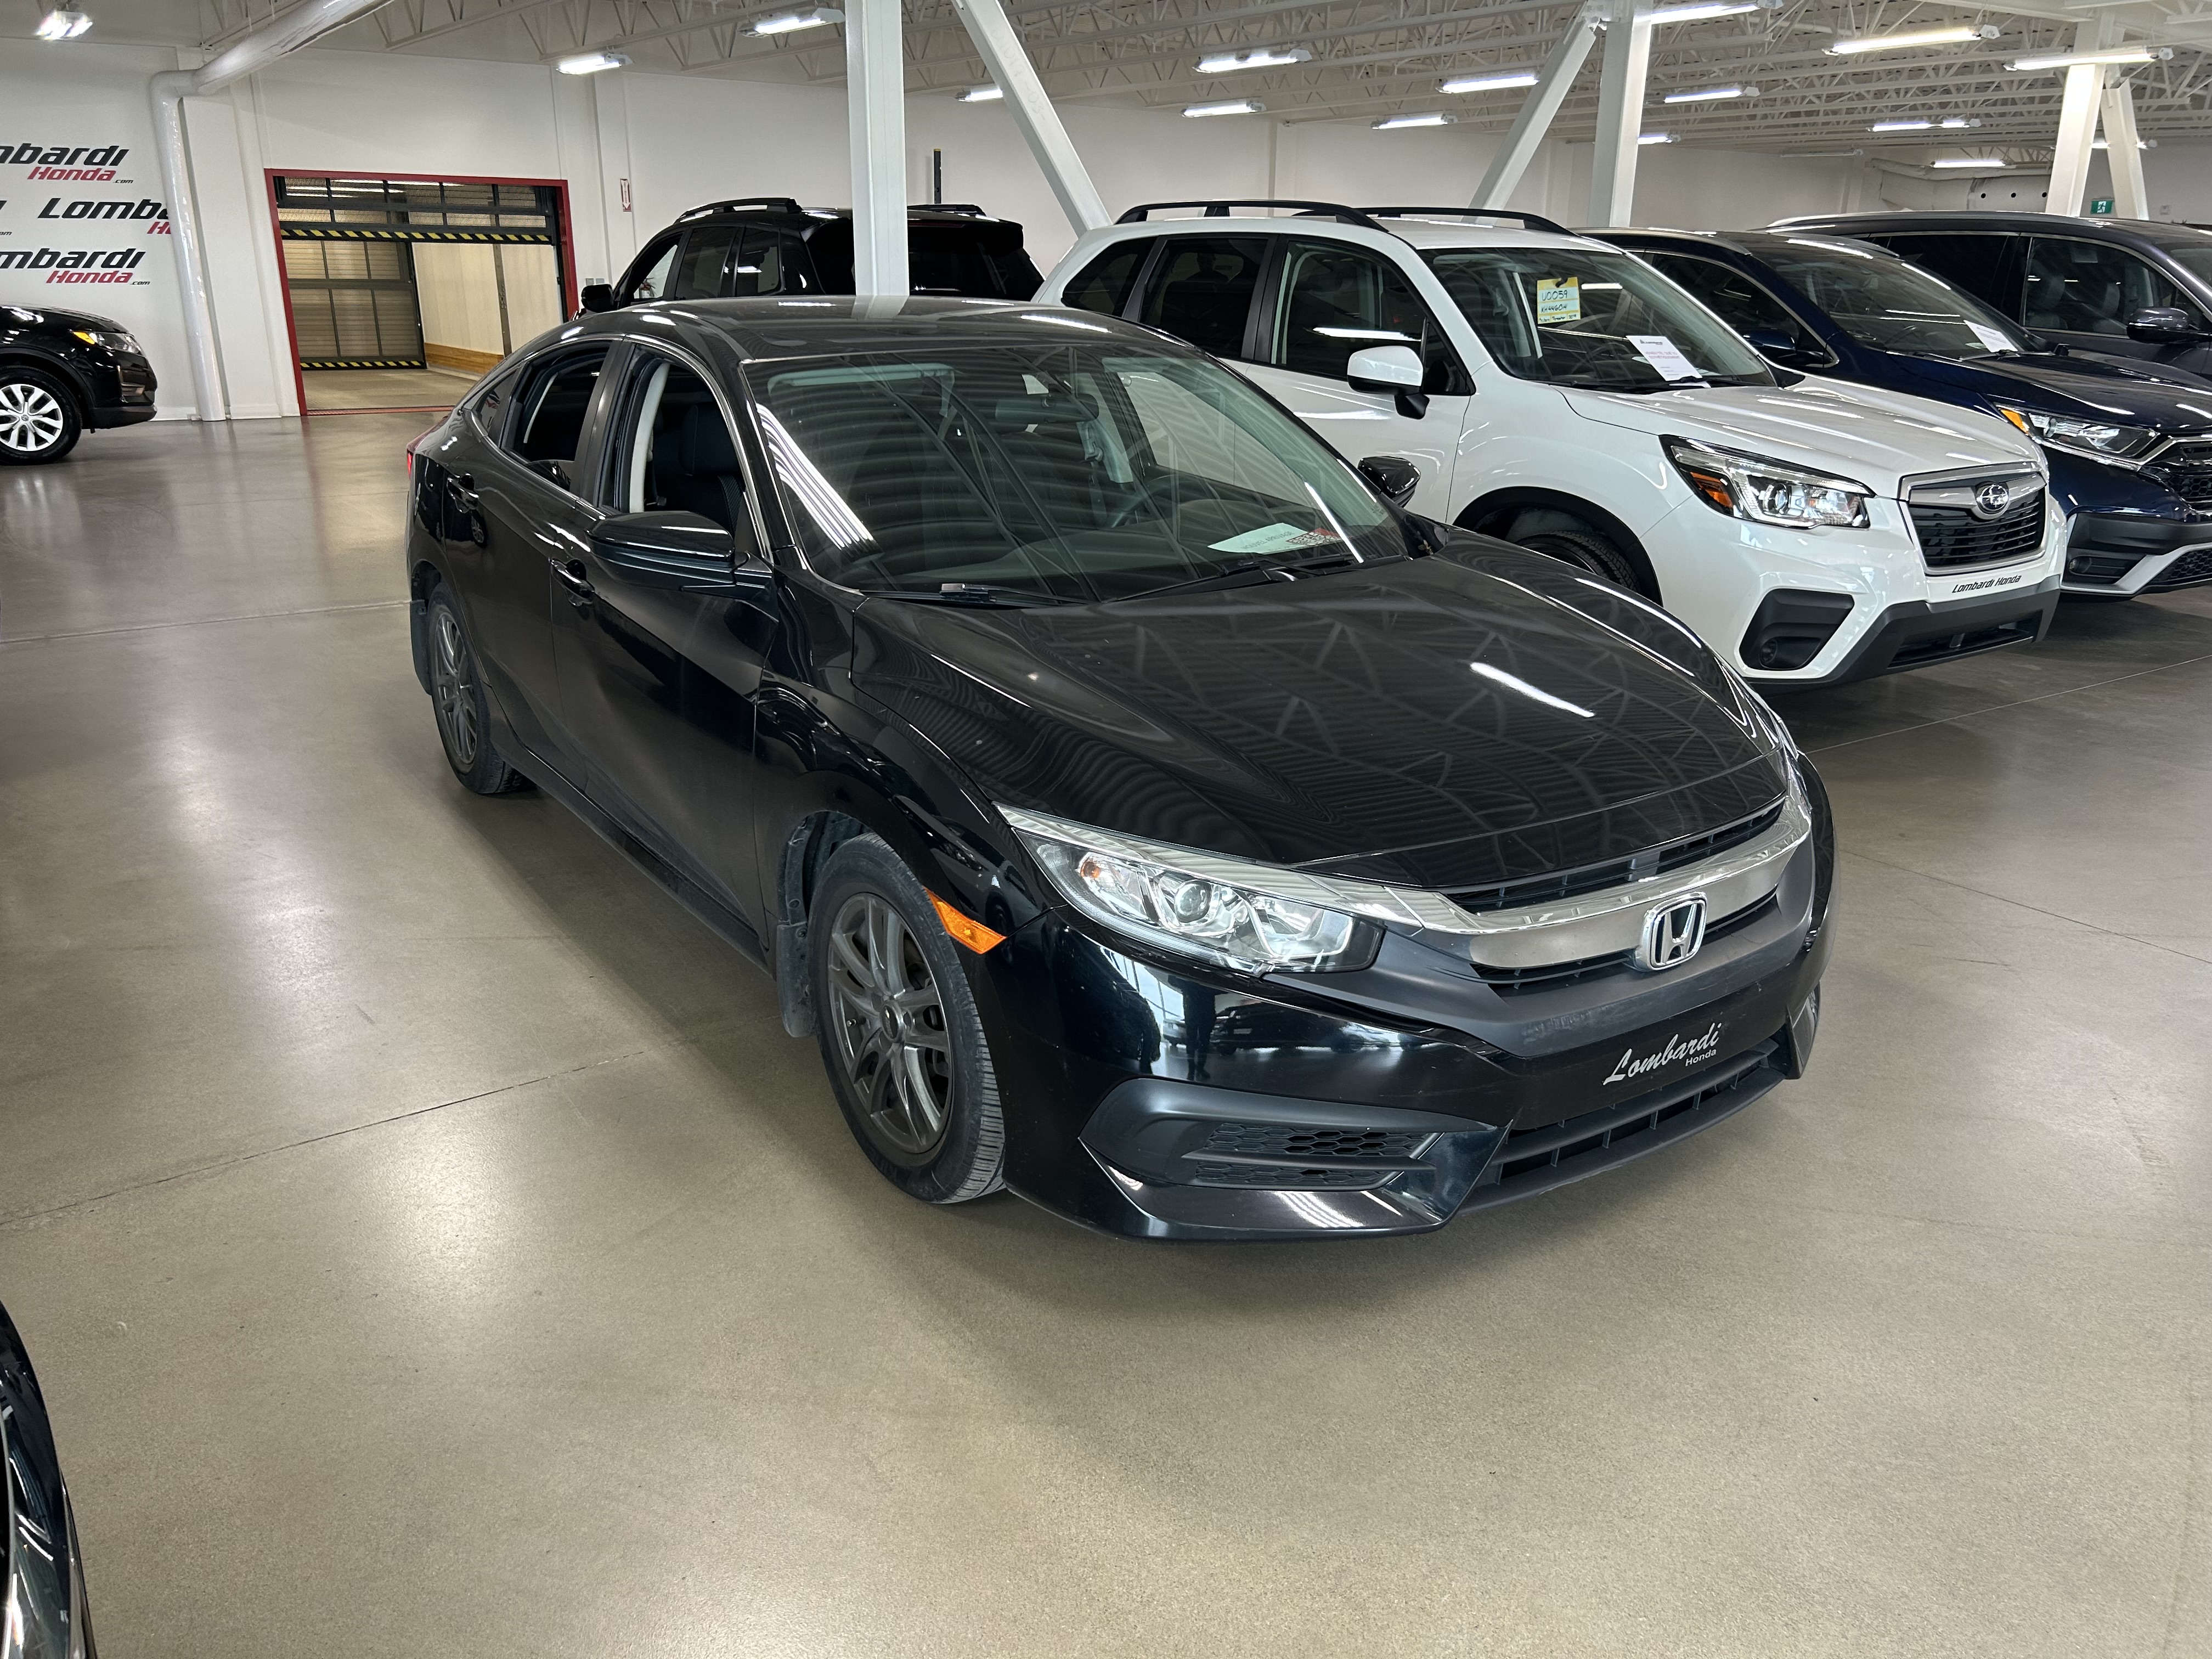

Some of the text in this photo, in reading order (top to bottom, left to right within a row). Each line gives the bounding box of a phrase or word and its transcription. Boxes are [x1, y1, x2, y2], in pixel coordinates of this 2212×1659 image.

[27, 166, 116, 181] Honda
[146, 222, 171, 234] H
[46, 270, 133, 284] Honda
[1951, 575, 2022, 593] Lombardi Honda
[1602, 1022, 1722, 1086] Lombardi
[1685, 1048, 1717, 1066] Honda
